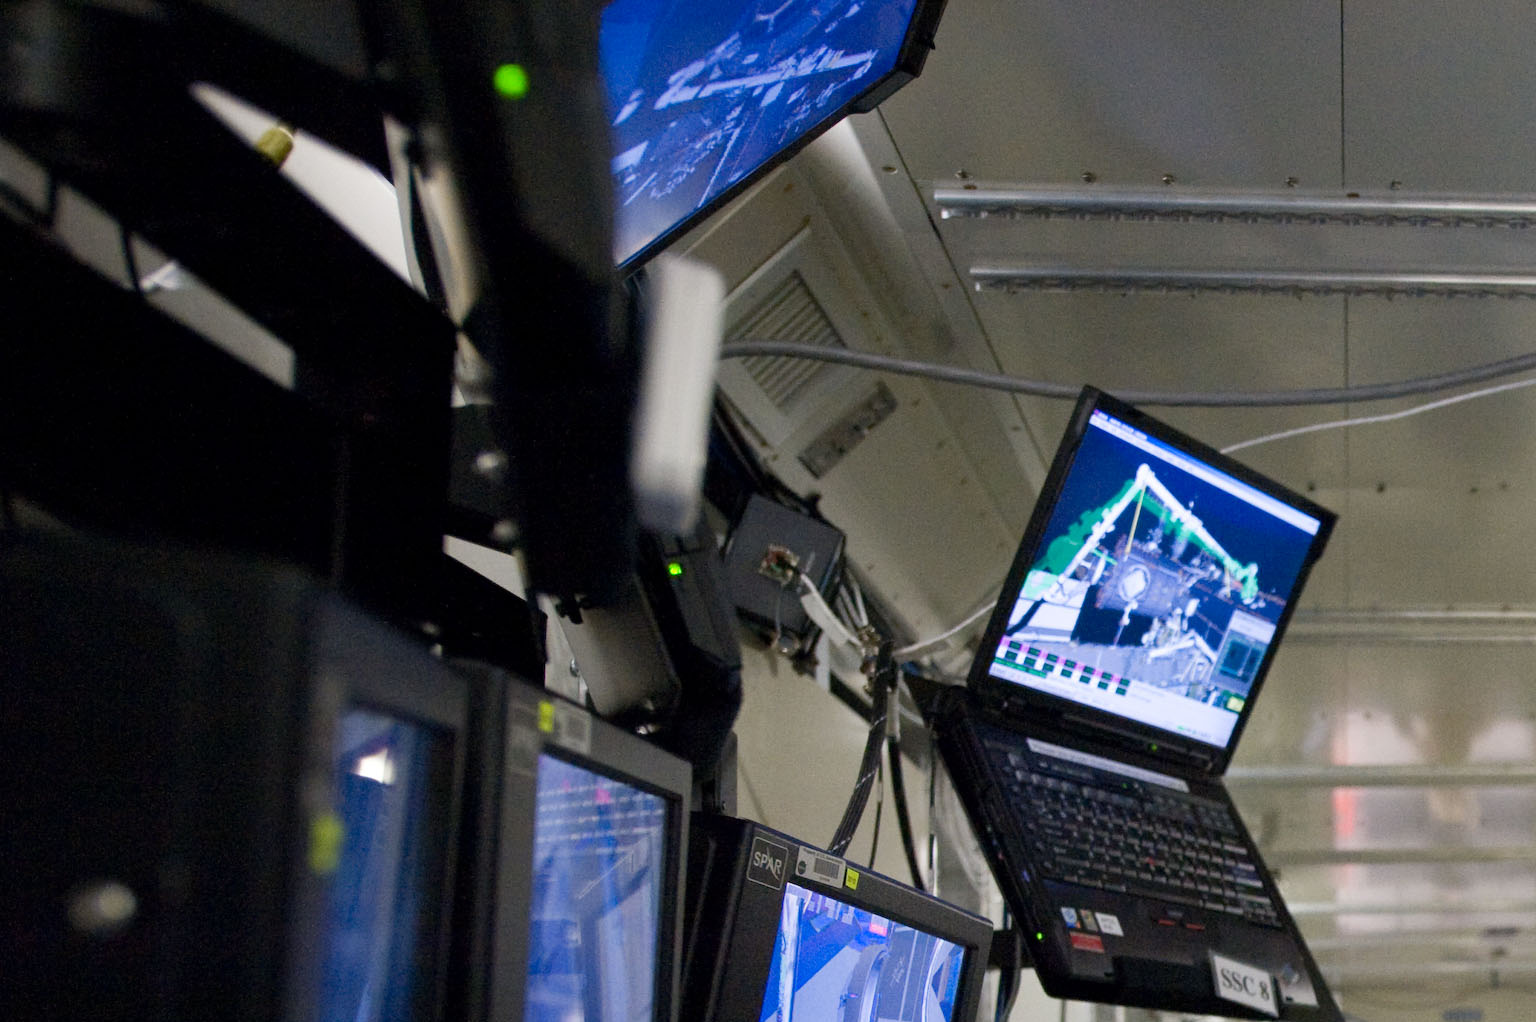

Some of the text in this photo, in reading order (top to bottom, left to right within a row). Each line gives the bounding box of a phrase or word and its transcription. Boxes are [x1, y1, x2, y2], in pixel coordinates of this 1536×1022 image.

[753, 847, 782, 880] SPAR
[1221, 968, 1270, 1001] SSC 8
